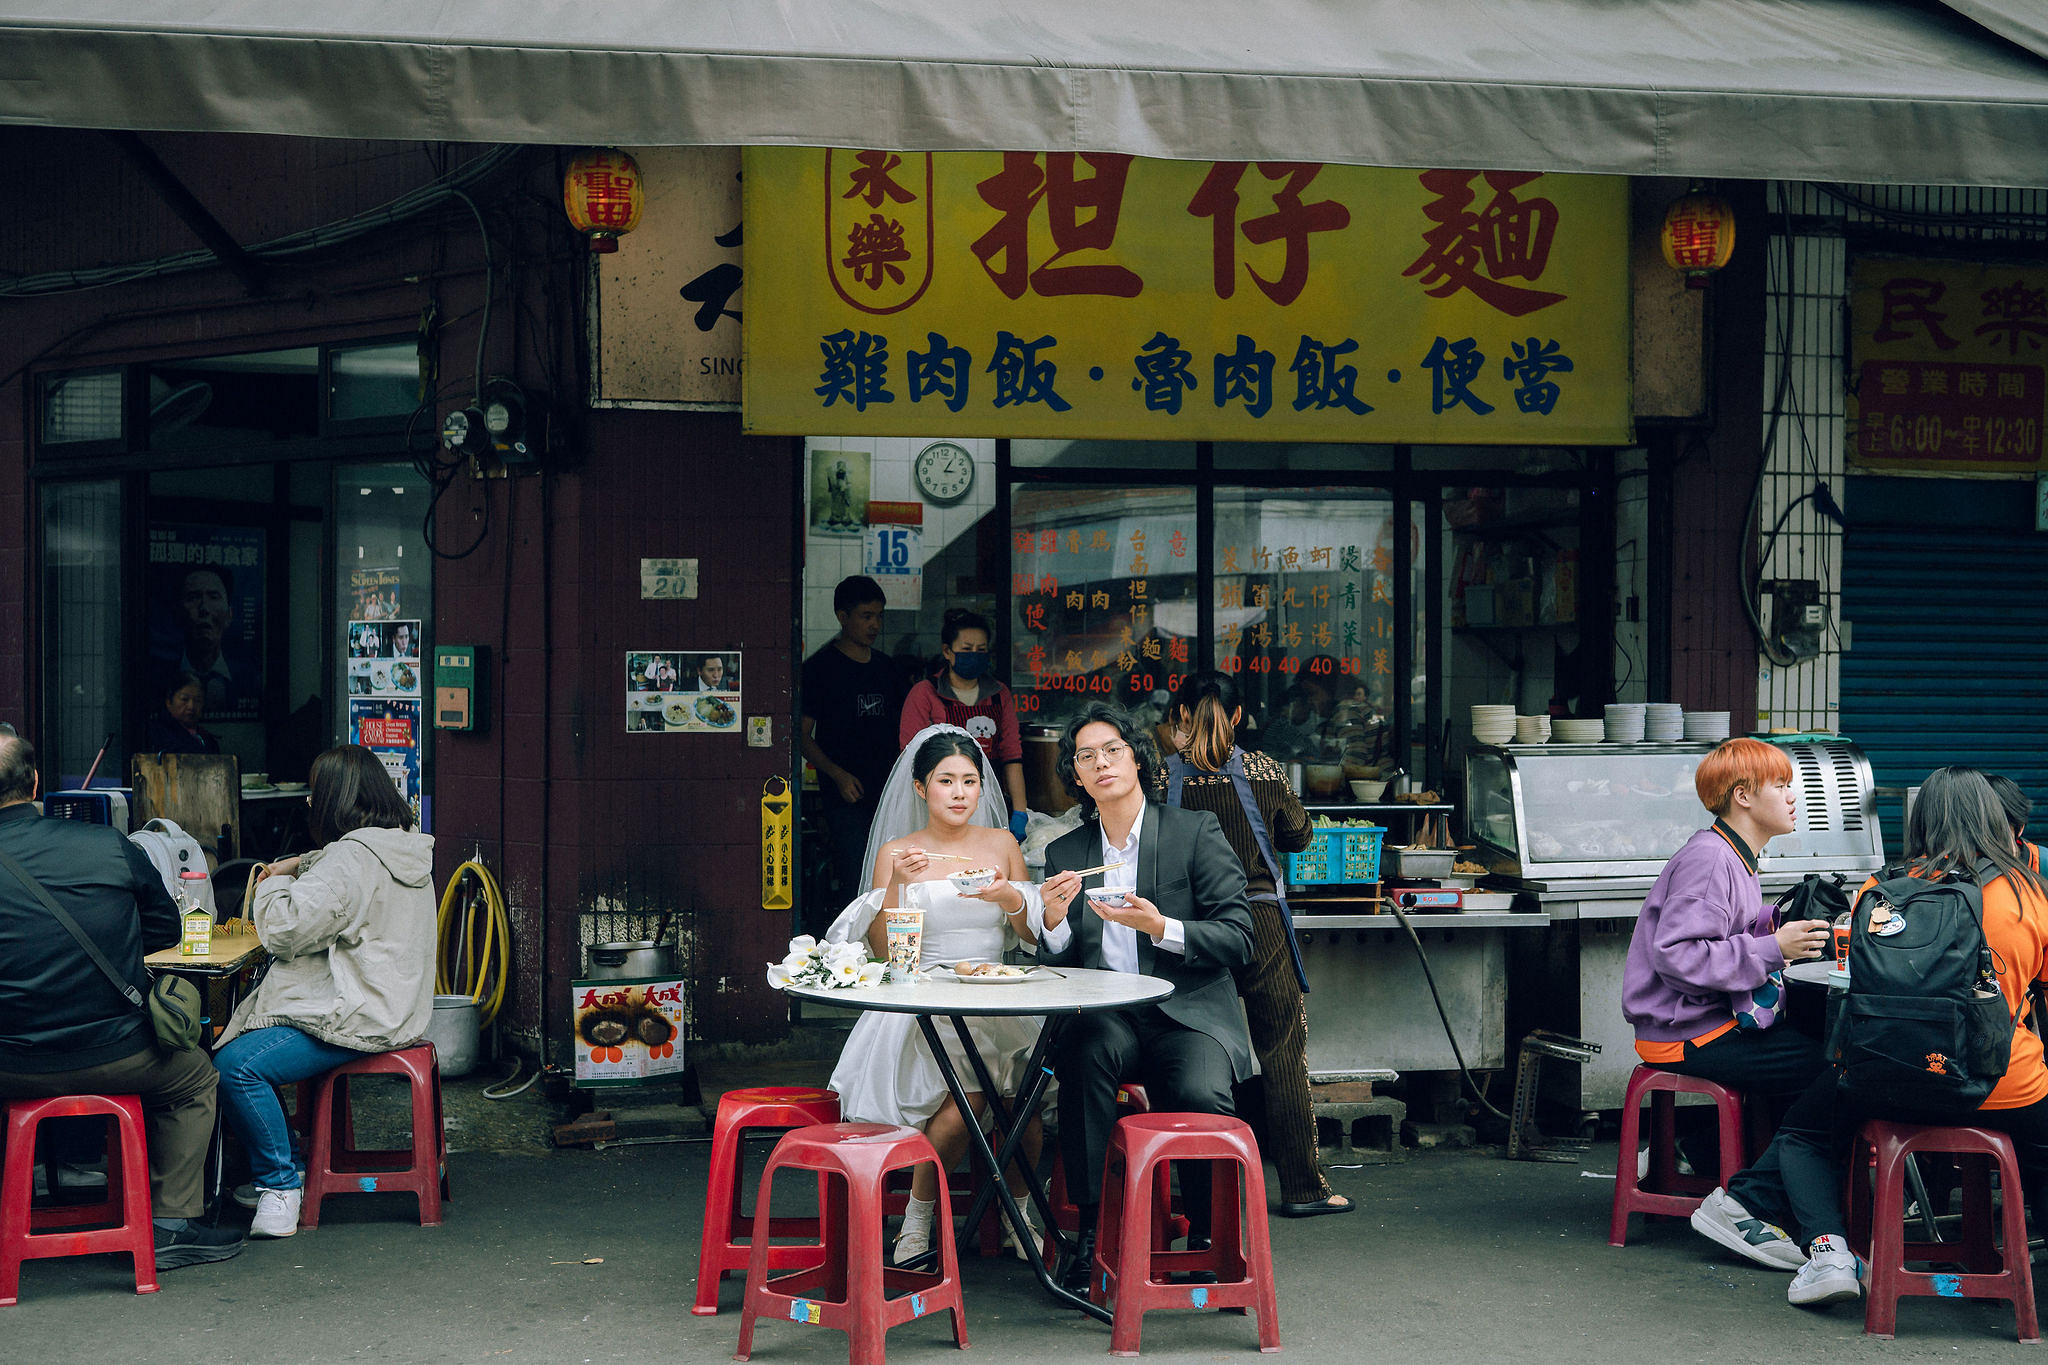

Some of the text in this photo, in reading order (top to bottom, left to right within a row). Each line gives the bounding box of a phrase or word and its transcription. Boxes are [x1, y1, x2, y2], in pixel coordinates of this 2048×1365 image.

[842, 150, 917, 291] 永樂
[815, 329, 1574, 418] 雞肉飯 魯肉飯 便當
[1881, 368, 2025, 398] 營業時間
[1963, 415, 1982, 455] 中午
[1984, 416, 2037, 455] 12:30
[877, 531, 908, 567] 15
[653, 577, 686, 596] 20
[1281, 546, 1304, 648] 魚丸湯
[1310, 546, 1336, 648] 蚵仔湯
[1026, 603, 1047, 673] 便當
[1220, 655, 1242, 673] 40
[1249, 655, 1271, 673] 40
[1278, 656, 1300, 674] 40
[1310, 656, 1332, 675] 40
[1340, 657, 1361, 675] 50
[1034, 672, 1062, 691] 120
[1064, 675, 1087, 693] 40
[1089, 675, 1112, 693] 40
[1130, 674, 1154, 692] 50
[1013, 694, 1040, 712] 130
[578, 987, 632, 1010] 大成
[641, 983, 682, 1007] 大成
